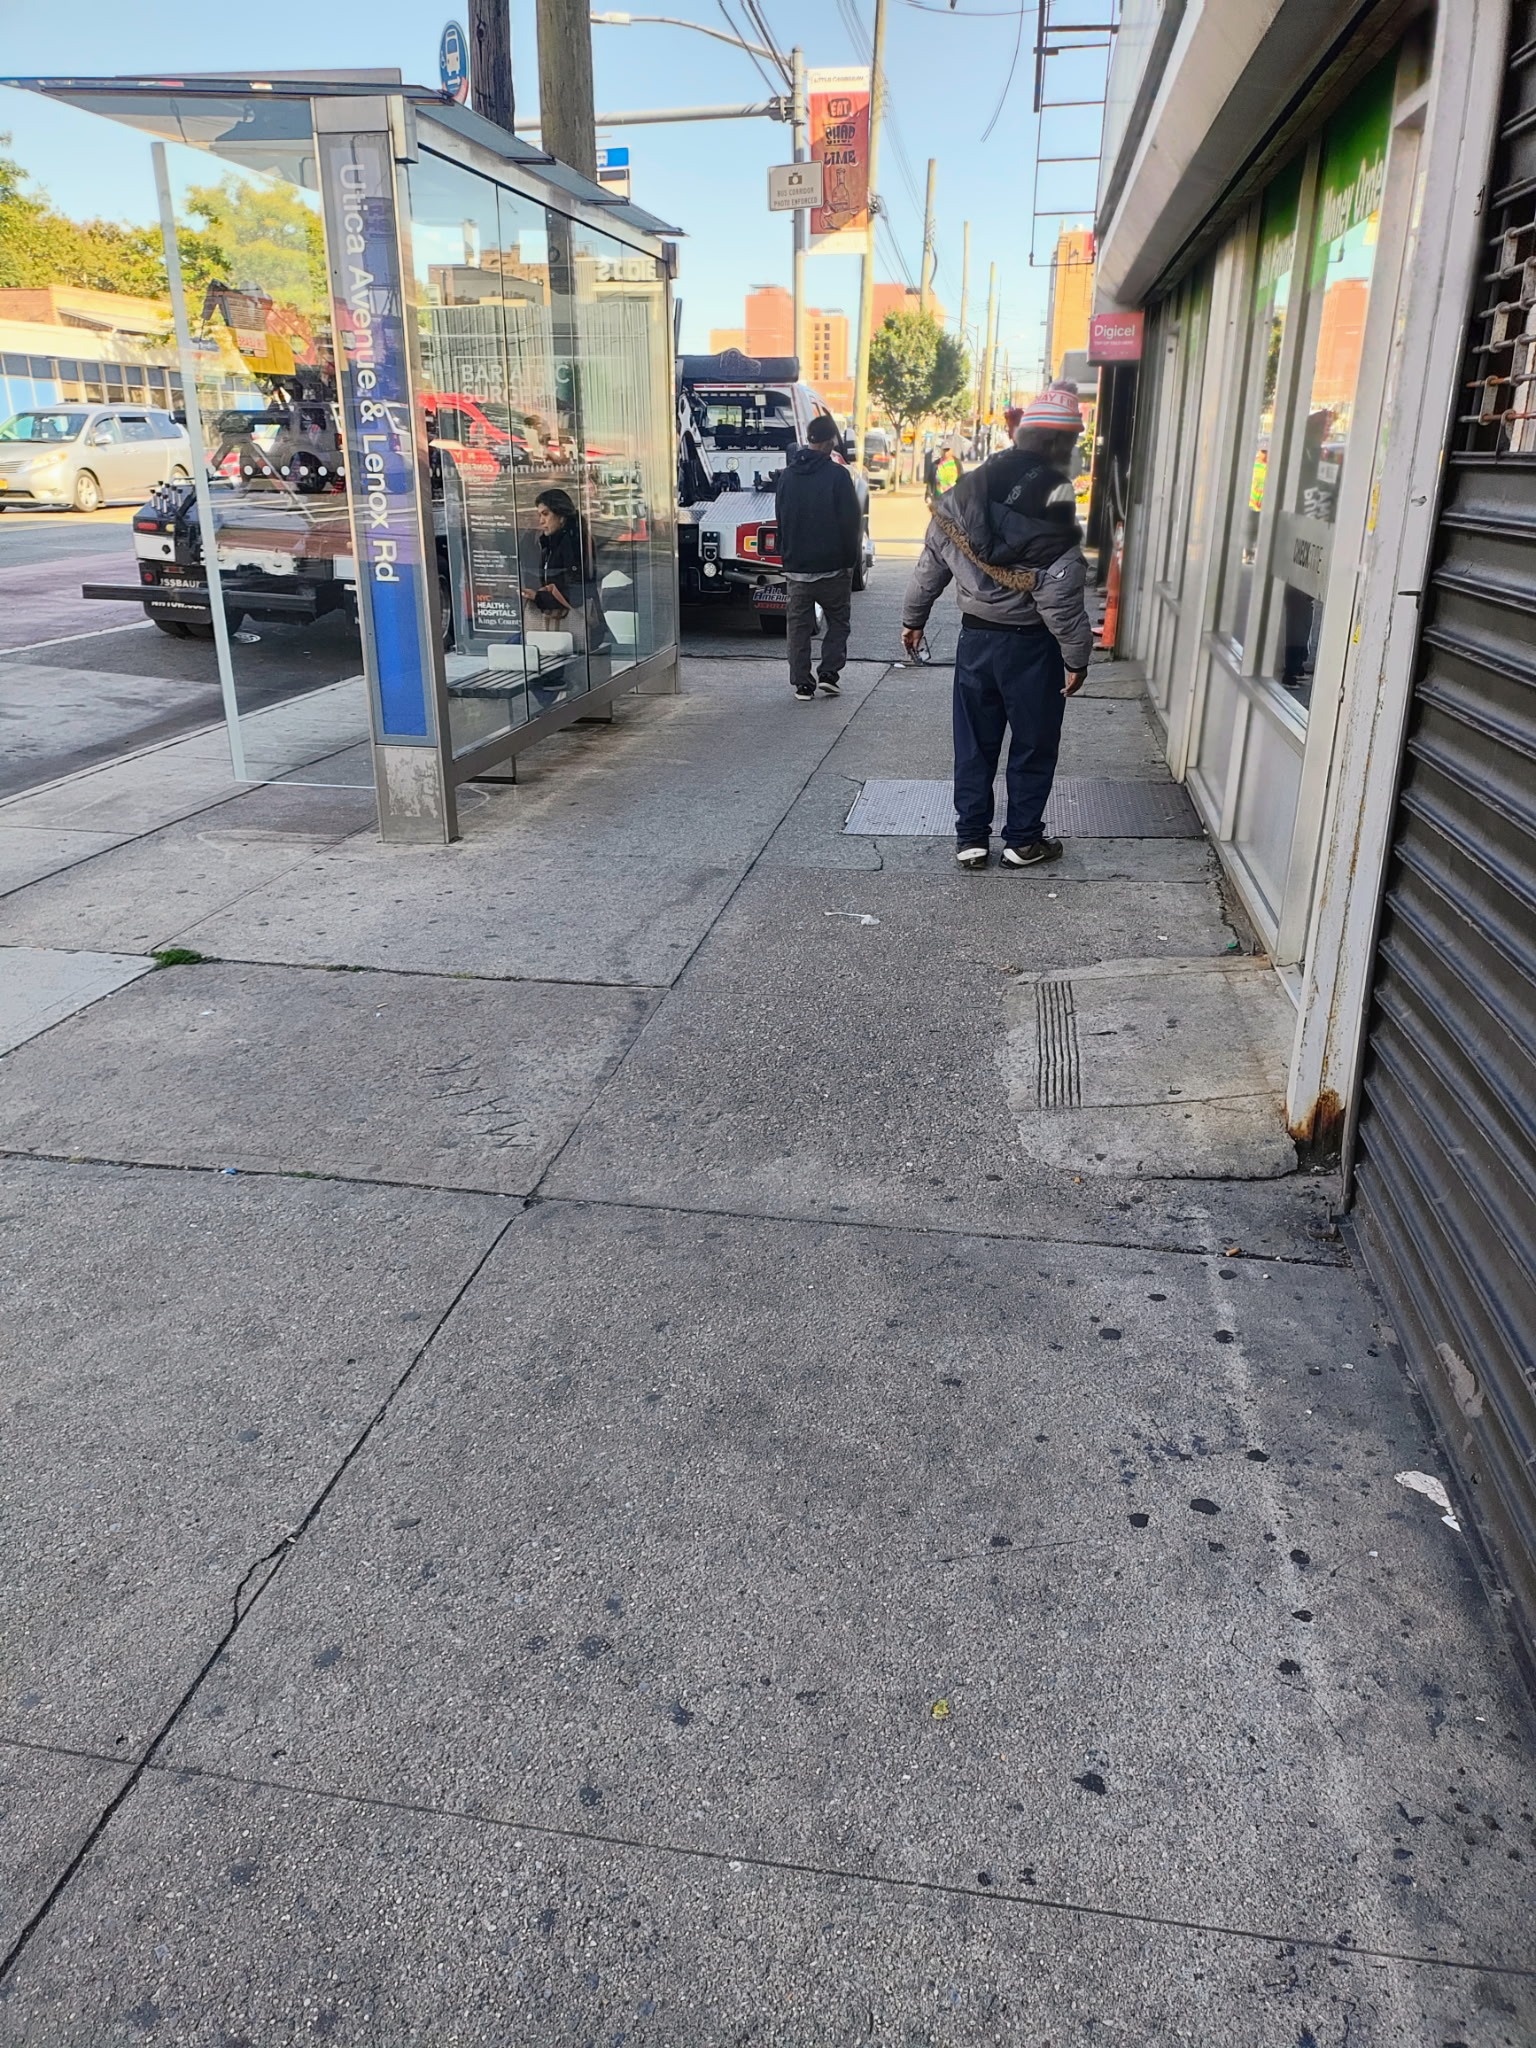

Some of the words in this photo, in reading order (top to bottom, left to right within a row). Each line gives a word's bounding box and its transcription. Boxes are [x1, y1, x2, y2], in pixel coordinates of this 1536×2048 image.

[830, 100, 849, 116] EAT
[823, 150, 856, 165] LIME
[777, 189, 787, 197] BUS
[340, 164, 369, 255] Utica
[348, 265, 377, 391] Avenue
[1094, 324, 1136, 340] Digicel
[360, 400, 385, 424] &
[362, 435, 390, 529] Lenox
[373, 540, 400, 582] Rd
[476, 594, 493, 602] NYC
[477, 609, 517, 617] HOSPITALS
[478, 617, 497, 626] Kings
